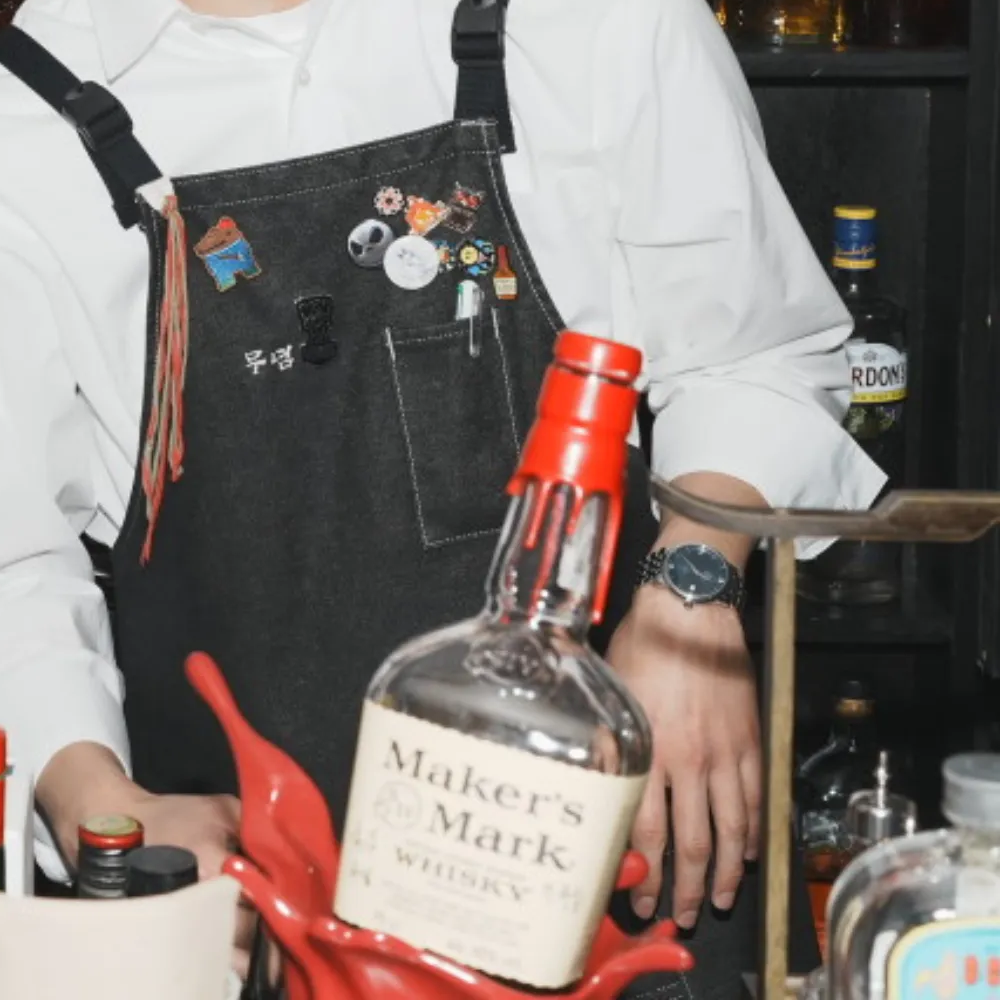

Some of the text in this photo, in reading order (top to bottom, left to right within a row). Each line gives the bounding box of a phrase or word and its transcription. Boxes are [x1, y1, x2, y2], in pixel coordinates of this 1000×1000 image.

[384, 739, 584, 827] Maker's
[428, 801, 576, 872] Mark
[395, 846, 533, 901] WHISKY
